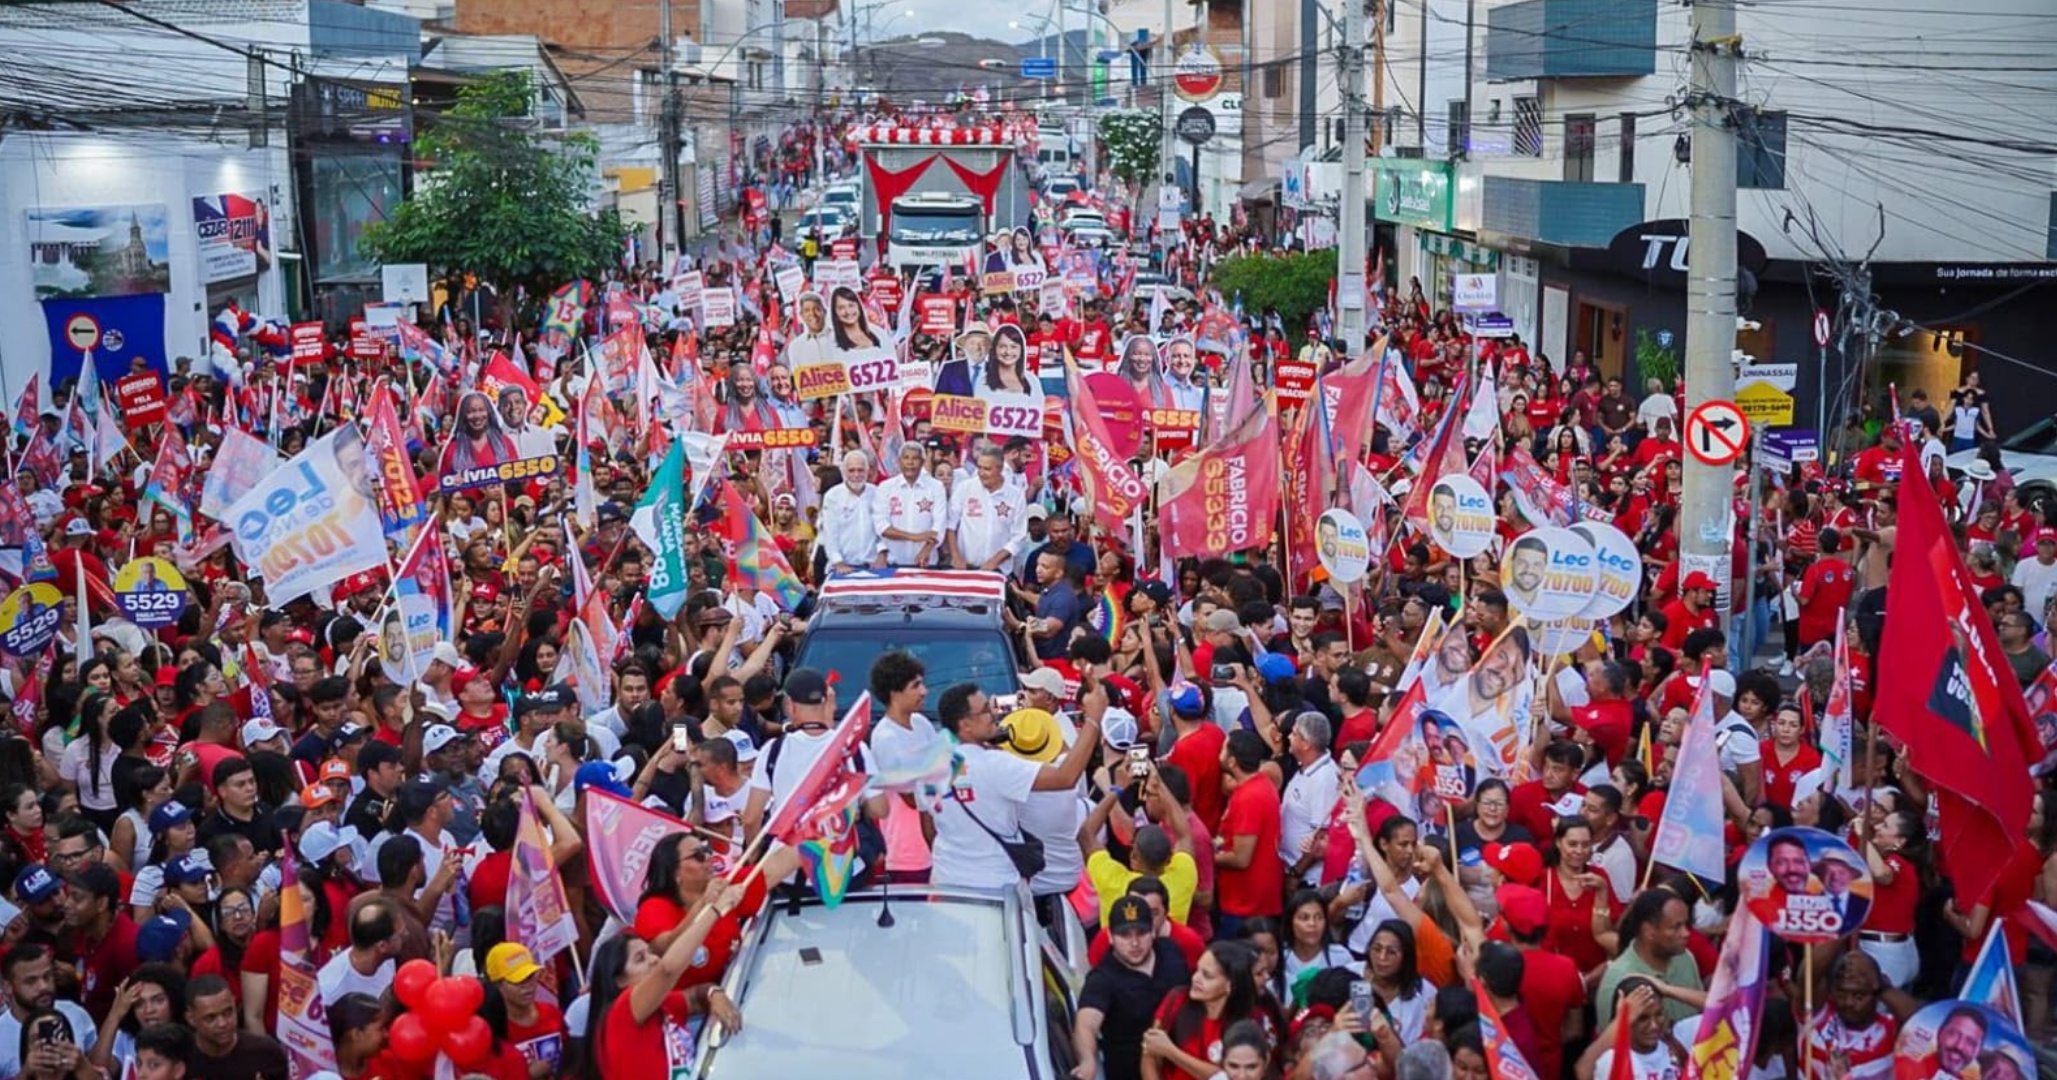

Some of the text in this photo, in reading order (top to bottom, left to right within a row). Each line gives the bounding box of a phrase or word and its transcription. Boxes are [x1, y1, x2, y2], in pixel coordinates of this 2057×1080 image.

[198, 218, 256, 240] CEZAR 12111
[987, 272, 1043, 287] Alice 6522
[1937, 267, 1955, 277] Sua
[1956, 267, 1994, 279] Jornada
[1996, 268, 2008, 277] de
[2010, 268, 2037, 277] forma
[556, 301, 576, 323] 13
[799, 360, 899, 390] Alice 6522
[1743, 369, 1796, 377] UNINASSAU
[934, 399, 1040, 431] Alice 6522
[733, 428, 815, 446] ÍVIA 6550
[499, 455, 557, 480] 6550
[1205, 457, 1228, 551] 65333
[1230, 455, 1248, 545] FABRICIO
[1459, 494, 1485, 509] Leo
[1340, 525, 1362, 539] Leo
[1455, 514, 1492, 533] 70700
[1552, 550, 1591, 567] Leo
[1597, 547, 1634, 571] Leo
[1543, 573, 1594, 594] 70700
[1600, 573, 1632, 600] 700
[124, 593, 180, 611] 5529
[6, 608, 60, 649] 5529
[408, 612, 430, 629] Leo
[1777, 909, 1843, 933] 1350
